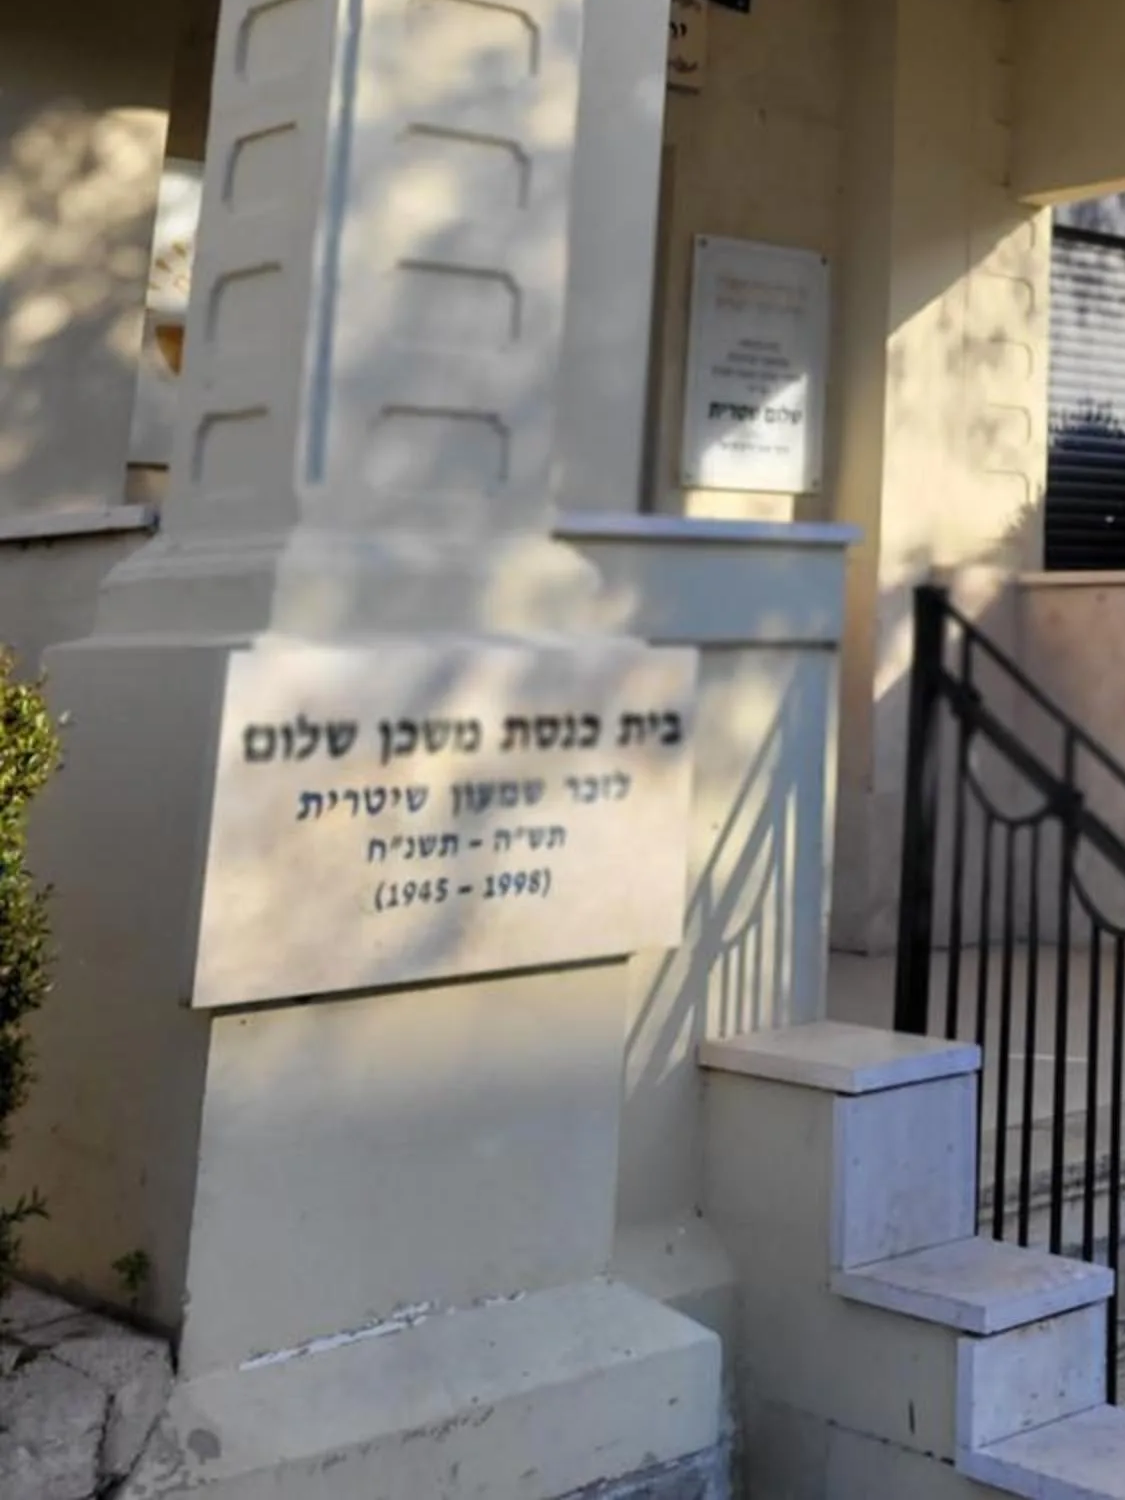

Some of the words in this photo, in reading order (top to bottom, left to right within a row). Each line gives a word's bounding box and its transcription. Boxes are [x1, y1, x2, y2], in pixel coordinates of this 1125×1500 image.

[242, 714, 359, 763] שלום
[376, 715, 483, 765] משכן
[499, 711, 602, 751] כנסת
[616, 708, 685, 749] בית
[295, 783, 429, 821] שיטרית
[449, 777, 547, 817] שמעון
[562, 768, 632, 802] לזכר
[372, 876, 450, 912] (1945
[481, 868, 553, 900] 1998)
